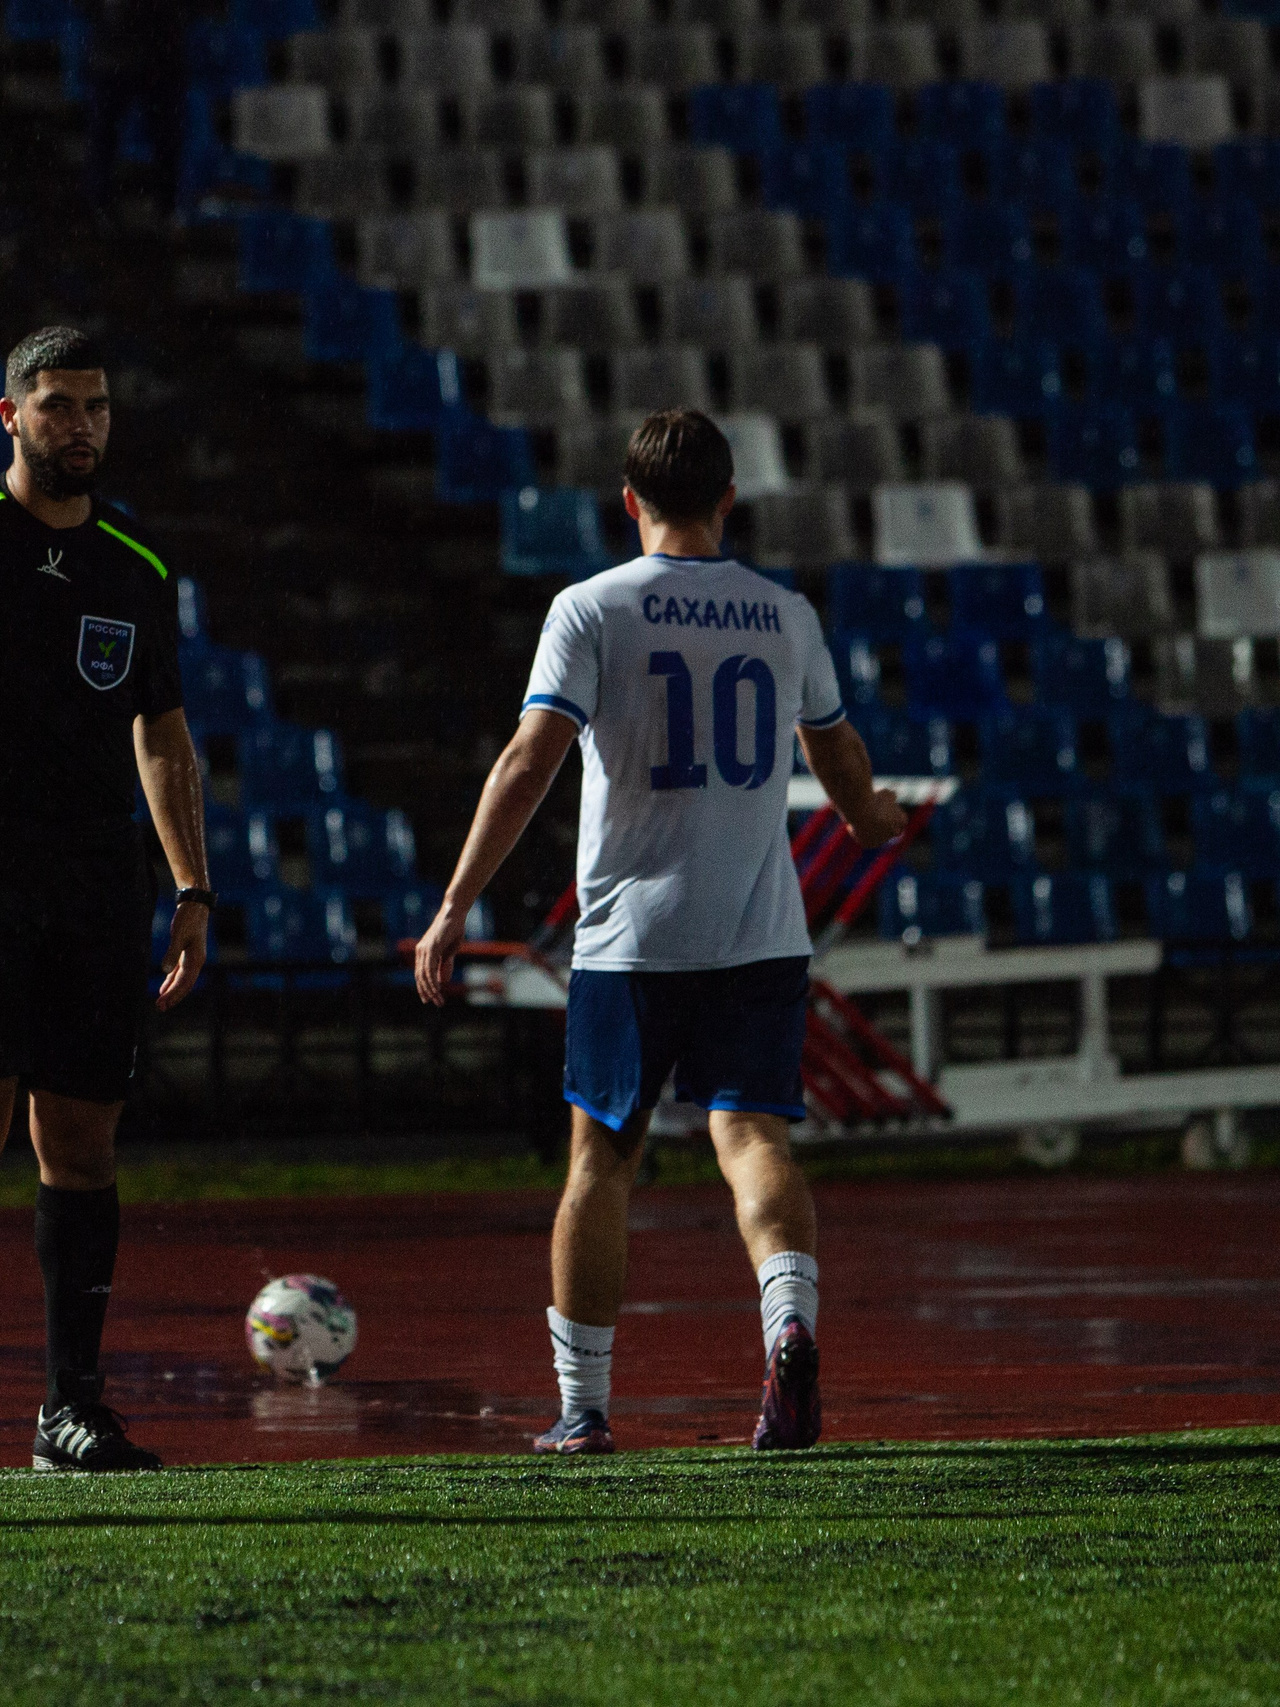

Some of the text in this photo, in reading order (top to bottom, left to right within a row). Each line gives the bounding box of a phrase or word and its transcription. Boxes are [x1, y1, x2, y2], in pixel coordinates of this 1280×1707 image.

[642, 594, 781, 634] САХАЛИН
[88, 623, 128, 637] РОССИЯ
[90, 660, 114, 671] ЮФЛ
[648, 651, 777, 791] 10
